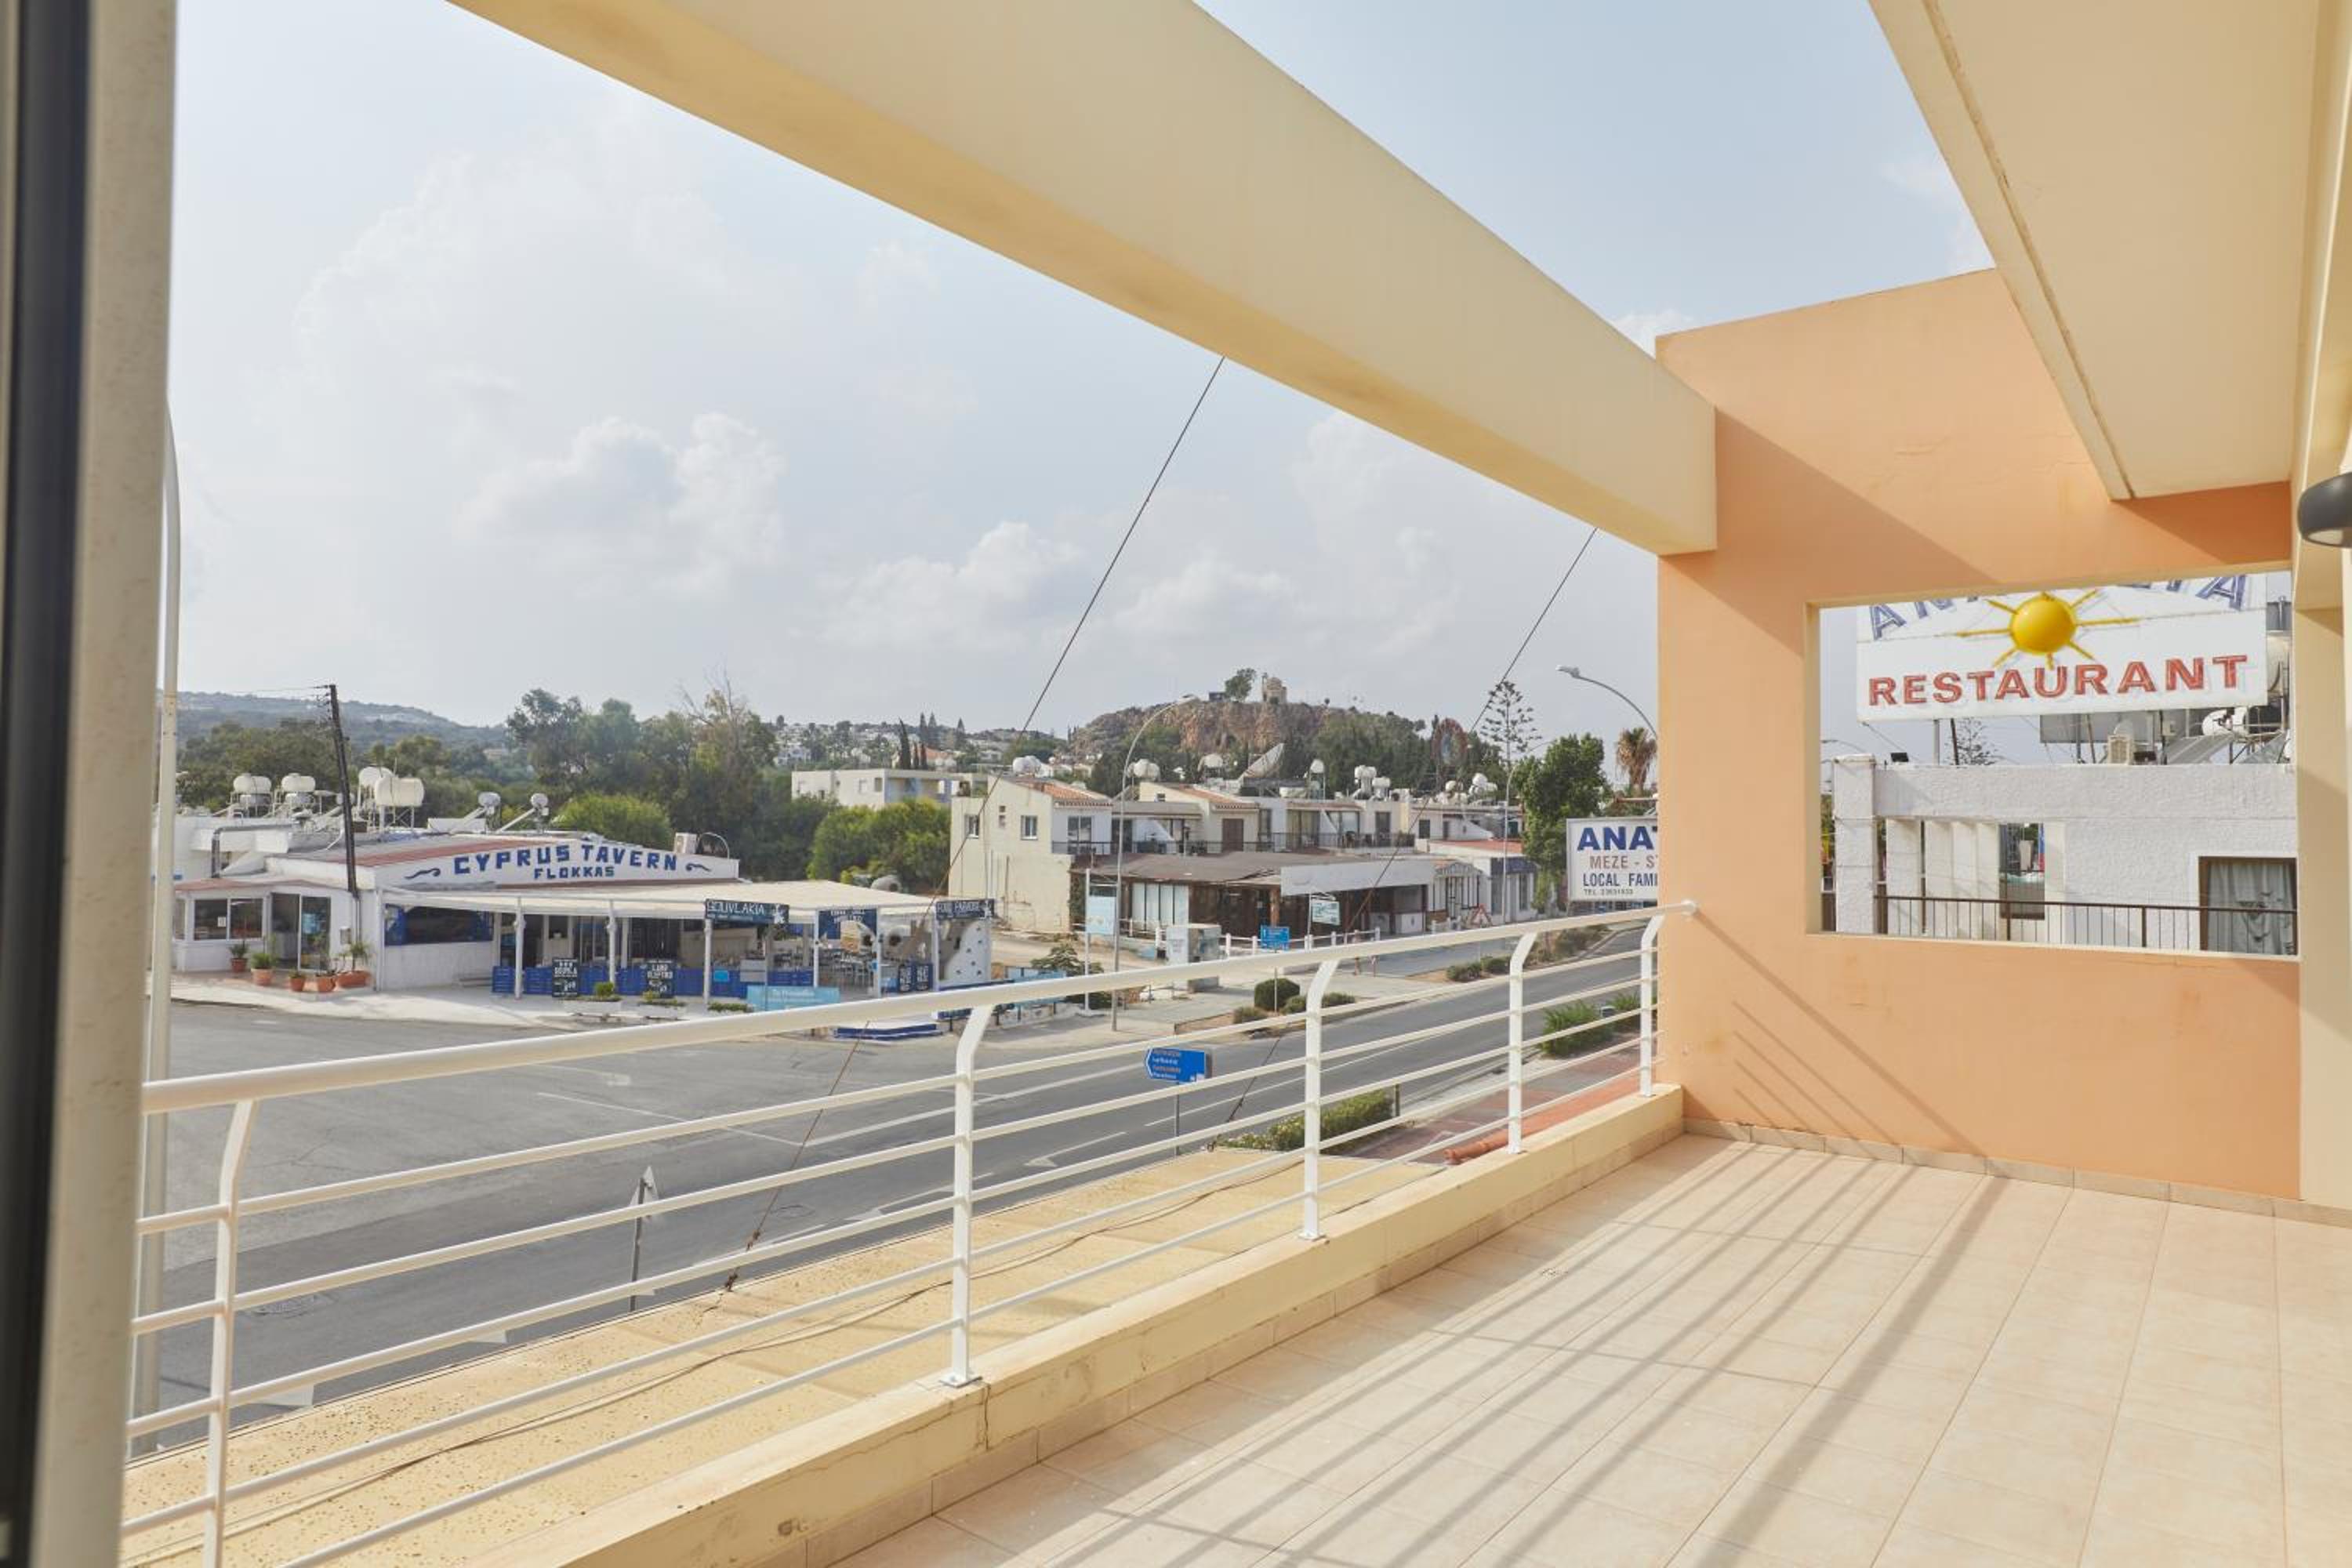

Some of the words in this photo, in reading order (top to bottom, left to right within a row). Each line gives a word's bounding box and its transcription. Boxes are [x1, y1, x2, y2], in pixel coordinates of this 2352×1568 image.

[1868, 654, 2249, 707] RESTAURANT
[1577, 826, 1657, 851] ANA
[454, 845, 569, 875] CYPRUS
[581, 844, 677, 871] TAVERN
[1590, 855, 1628, 869] MEZE
[1646, 855, 1657, 869] S
[534, 866, 615, 880] FLOKKAS
[1583, 873, 1620, 887] LOCAL
